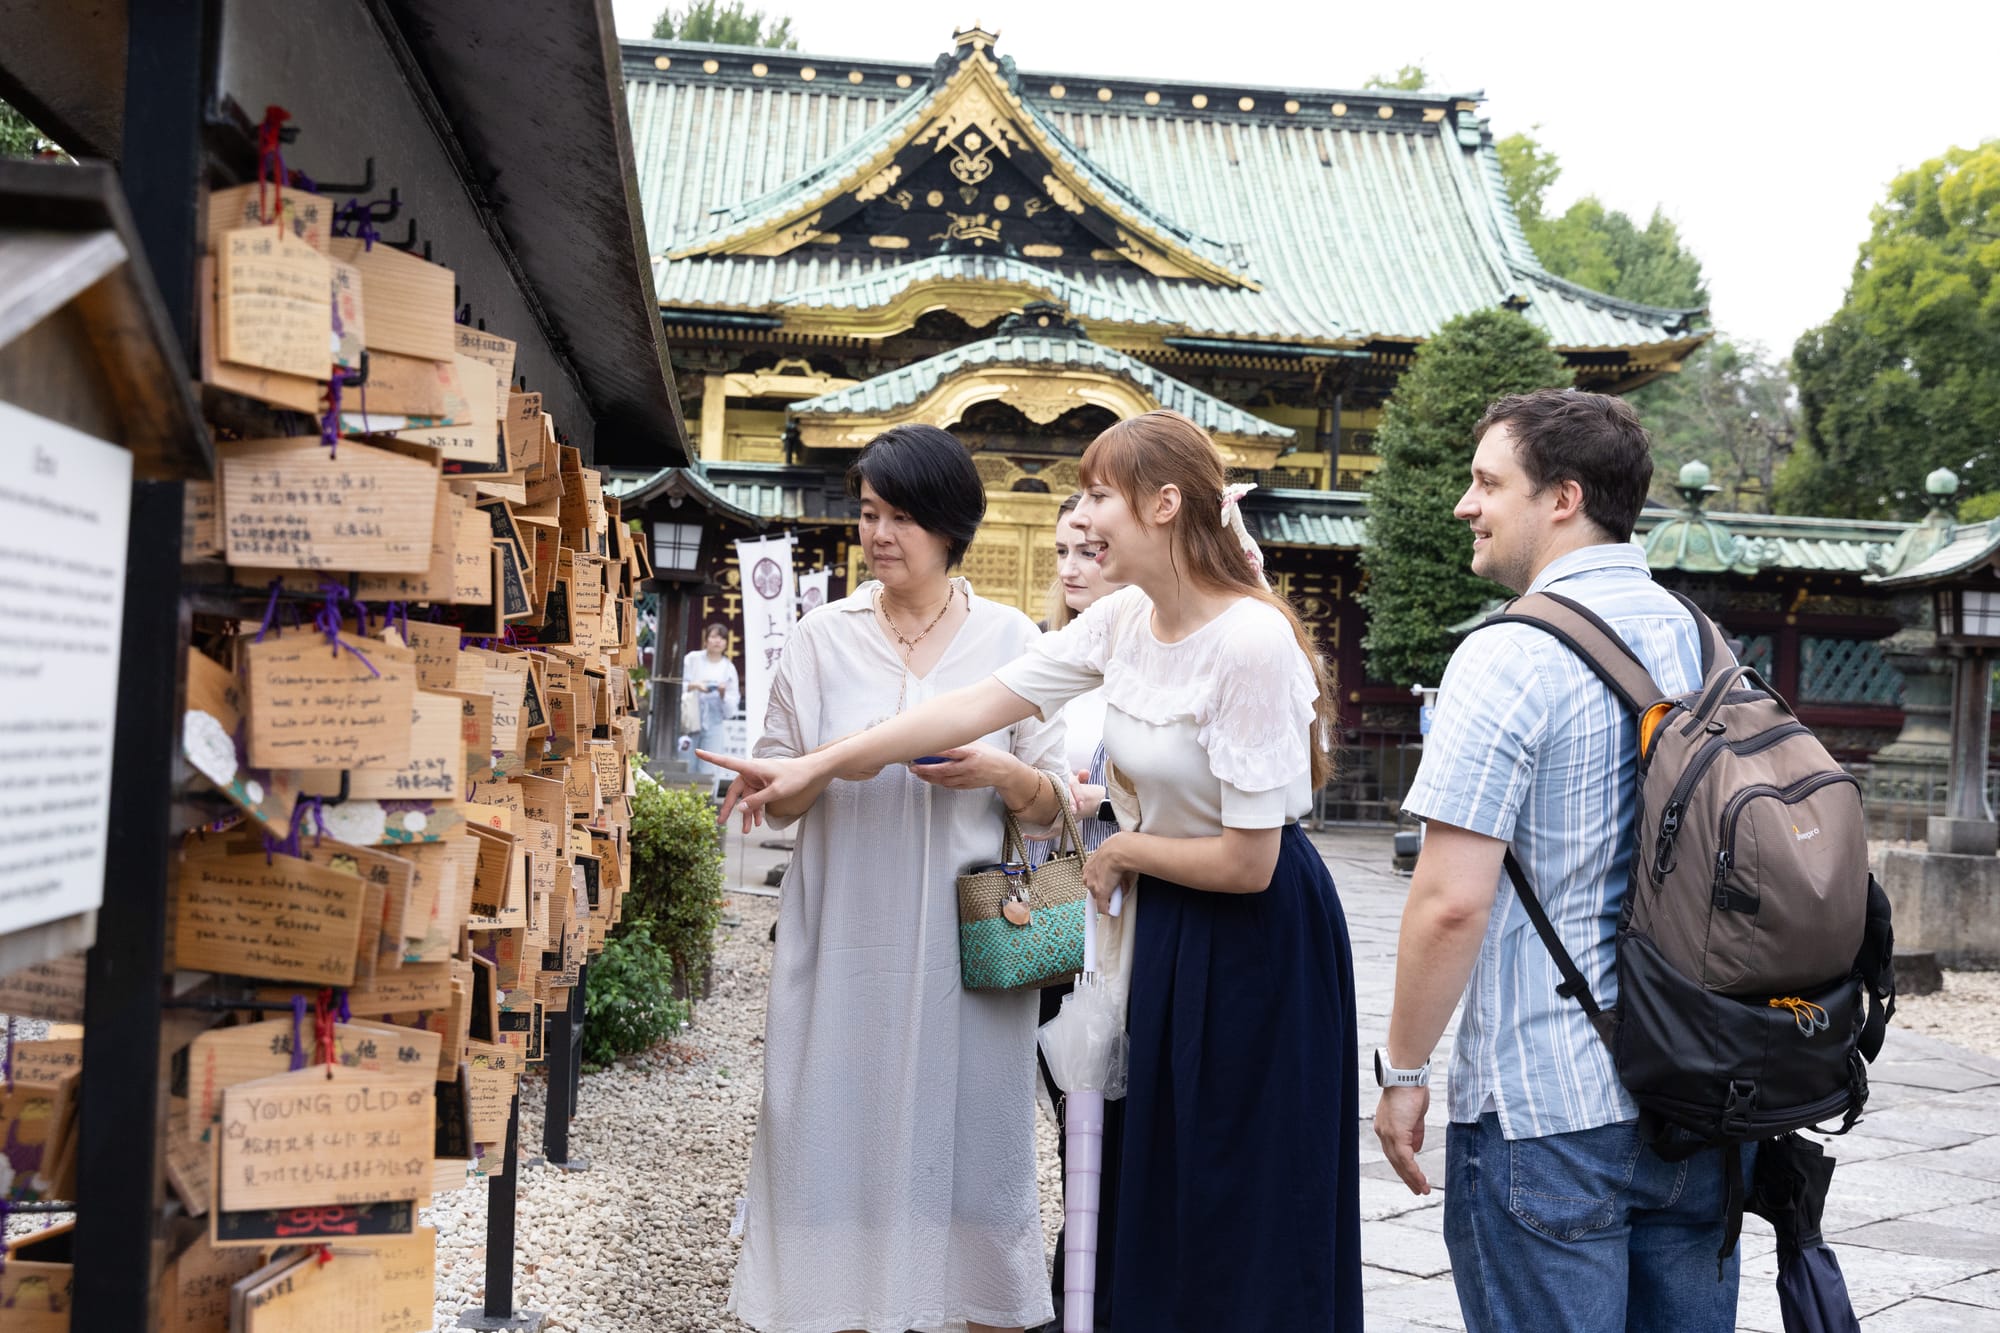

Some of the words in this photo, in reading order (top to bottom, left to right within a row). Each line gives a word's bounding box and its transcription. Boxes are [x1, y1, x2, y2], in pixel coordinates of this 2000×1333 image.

[763, 613, 784, 671] 上野
[248, 1092, 332, 1121] YOUNG
[345, 1087, 398, 1113] OLD
